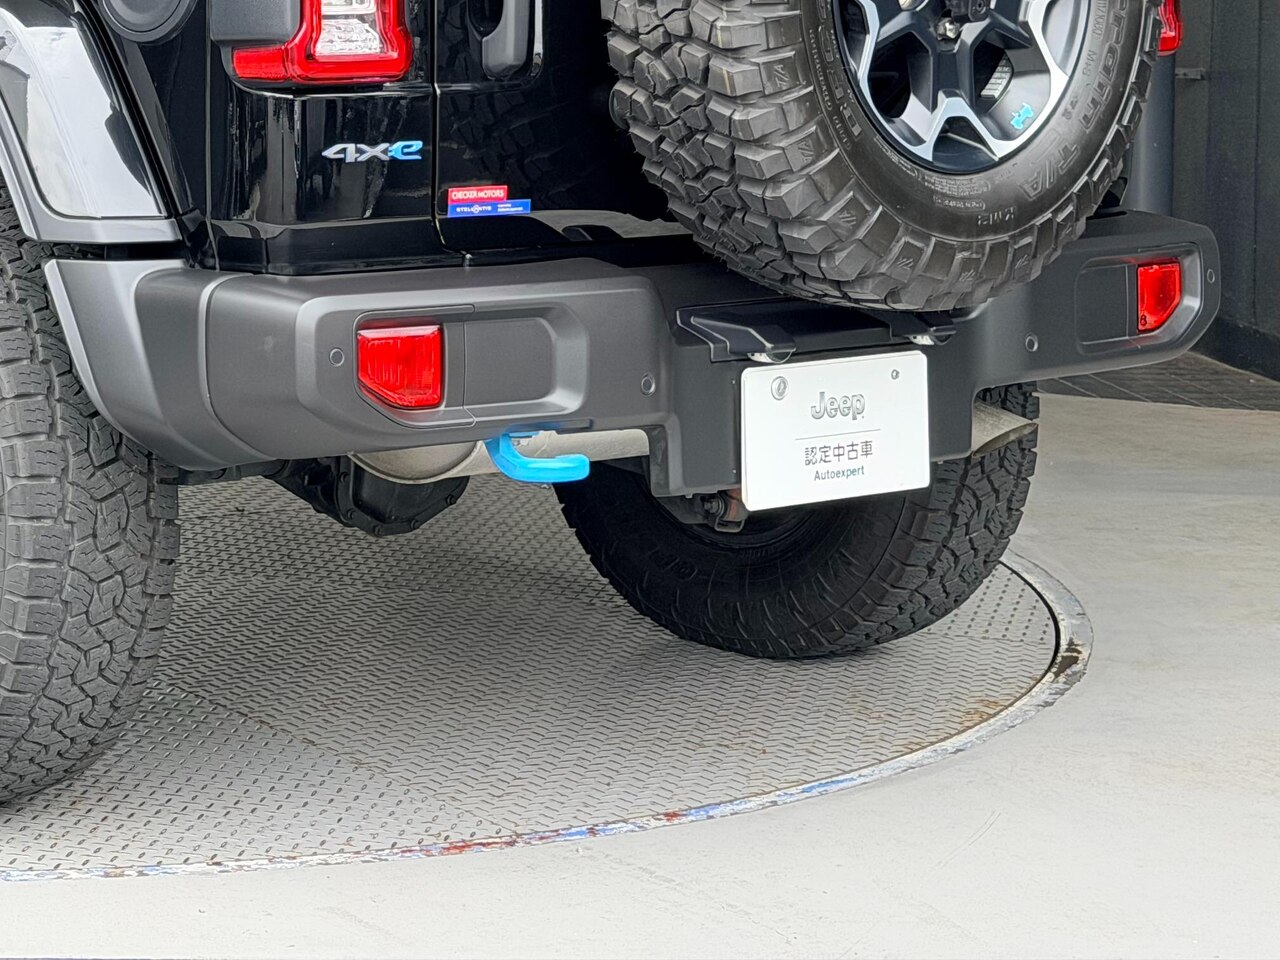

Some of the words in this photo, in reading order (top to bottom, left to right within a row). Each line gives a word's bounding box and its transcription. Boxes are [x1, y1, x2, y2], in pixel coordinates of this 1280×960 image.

[810, 391, 866, 421] Jeep
[804, 440, 874, 466] 認定中古車
[813, 465, 866, 482] Autoexpert
